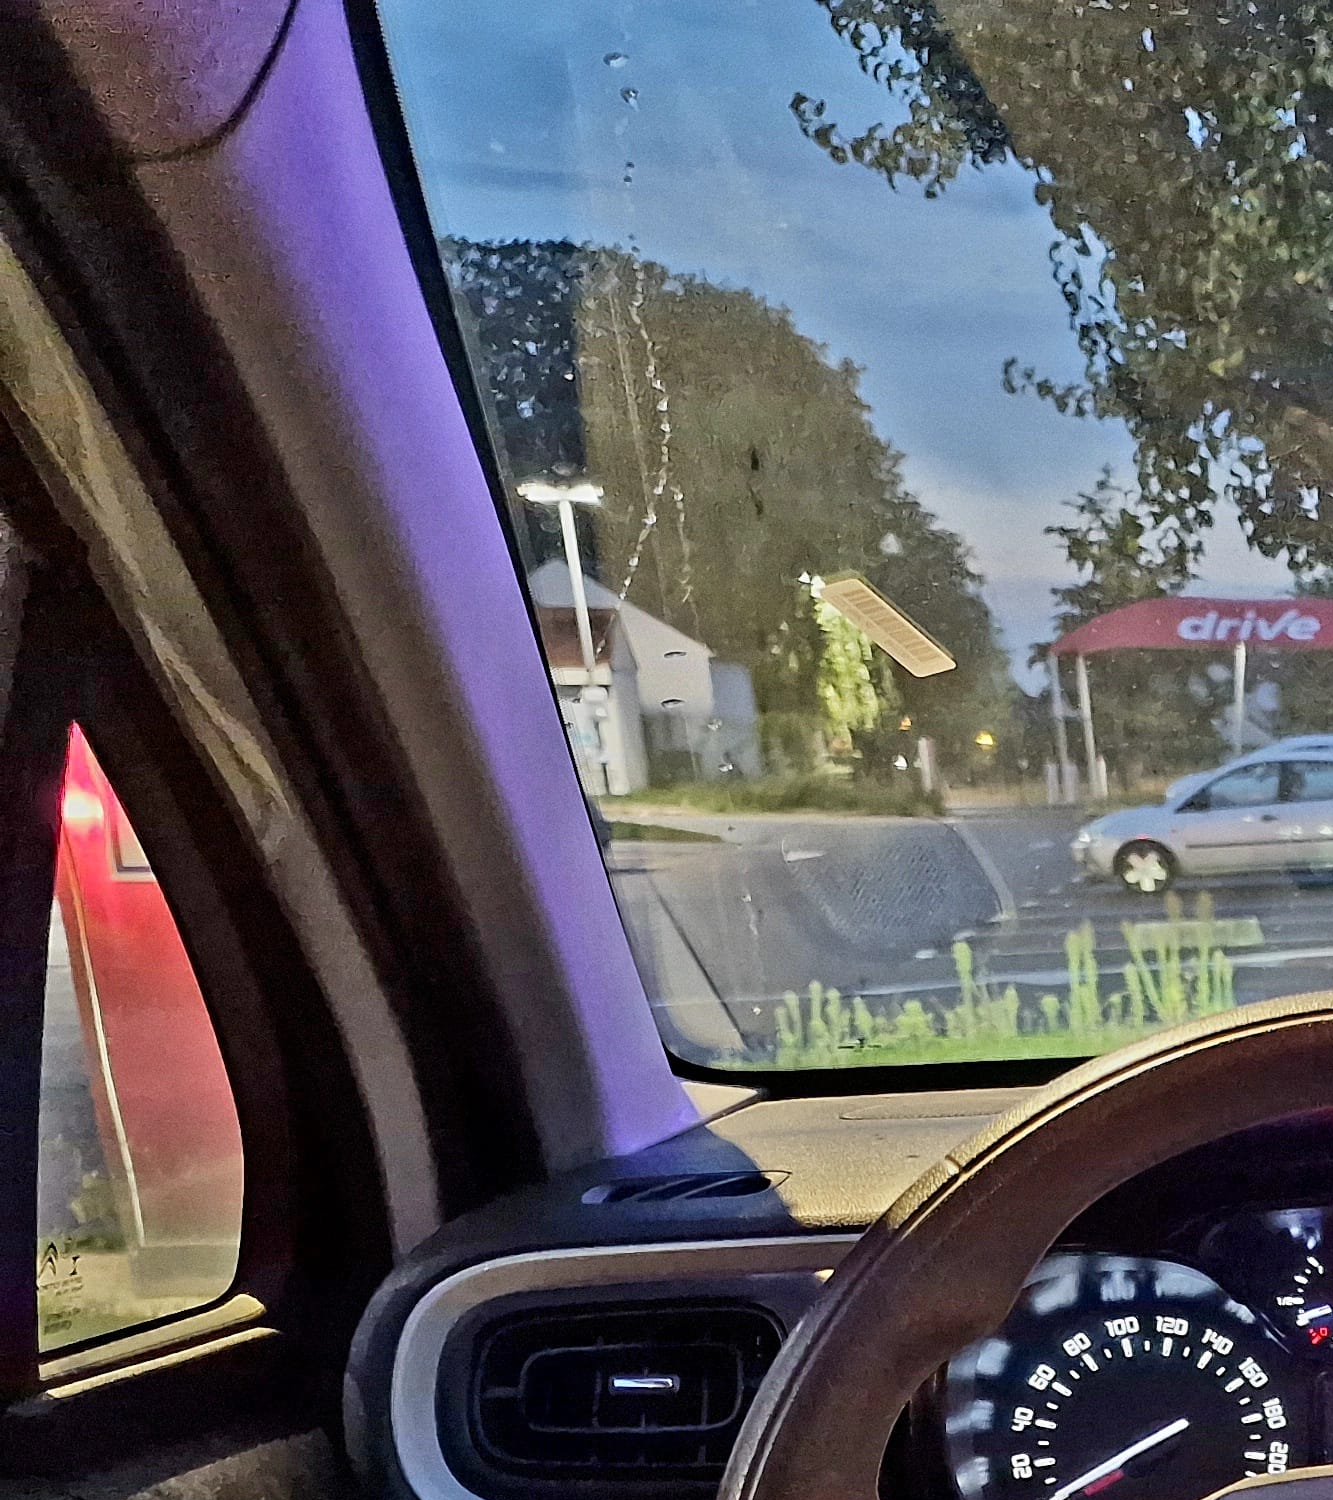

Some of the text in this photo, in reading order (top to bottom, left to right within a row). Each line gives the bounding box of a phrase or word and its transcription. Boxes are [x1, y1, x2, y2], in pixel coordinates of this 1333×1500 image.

[1178, 610, 1321, 641] drive
[1104, 1315, 1140, 1336] 100
[1155, 1315, 1189, 1337] 120
[1062, 1331, 1092, 1358] 80
[1201, 1328, 1234, 1356] 140
[1028, 1363, 1056, 1391] 60
[1238, 1357, 1269, 1389] 160
[1011, 1406, 1034, 1432] 40
[1262, 1397, 1287, 1430] 180
[1011, 1454, 1033, 1479] 20
[1268, 1441, 1290, 1474] 200
